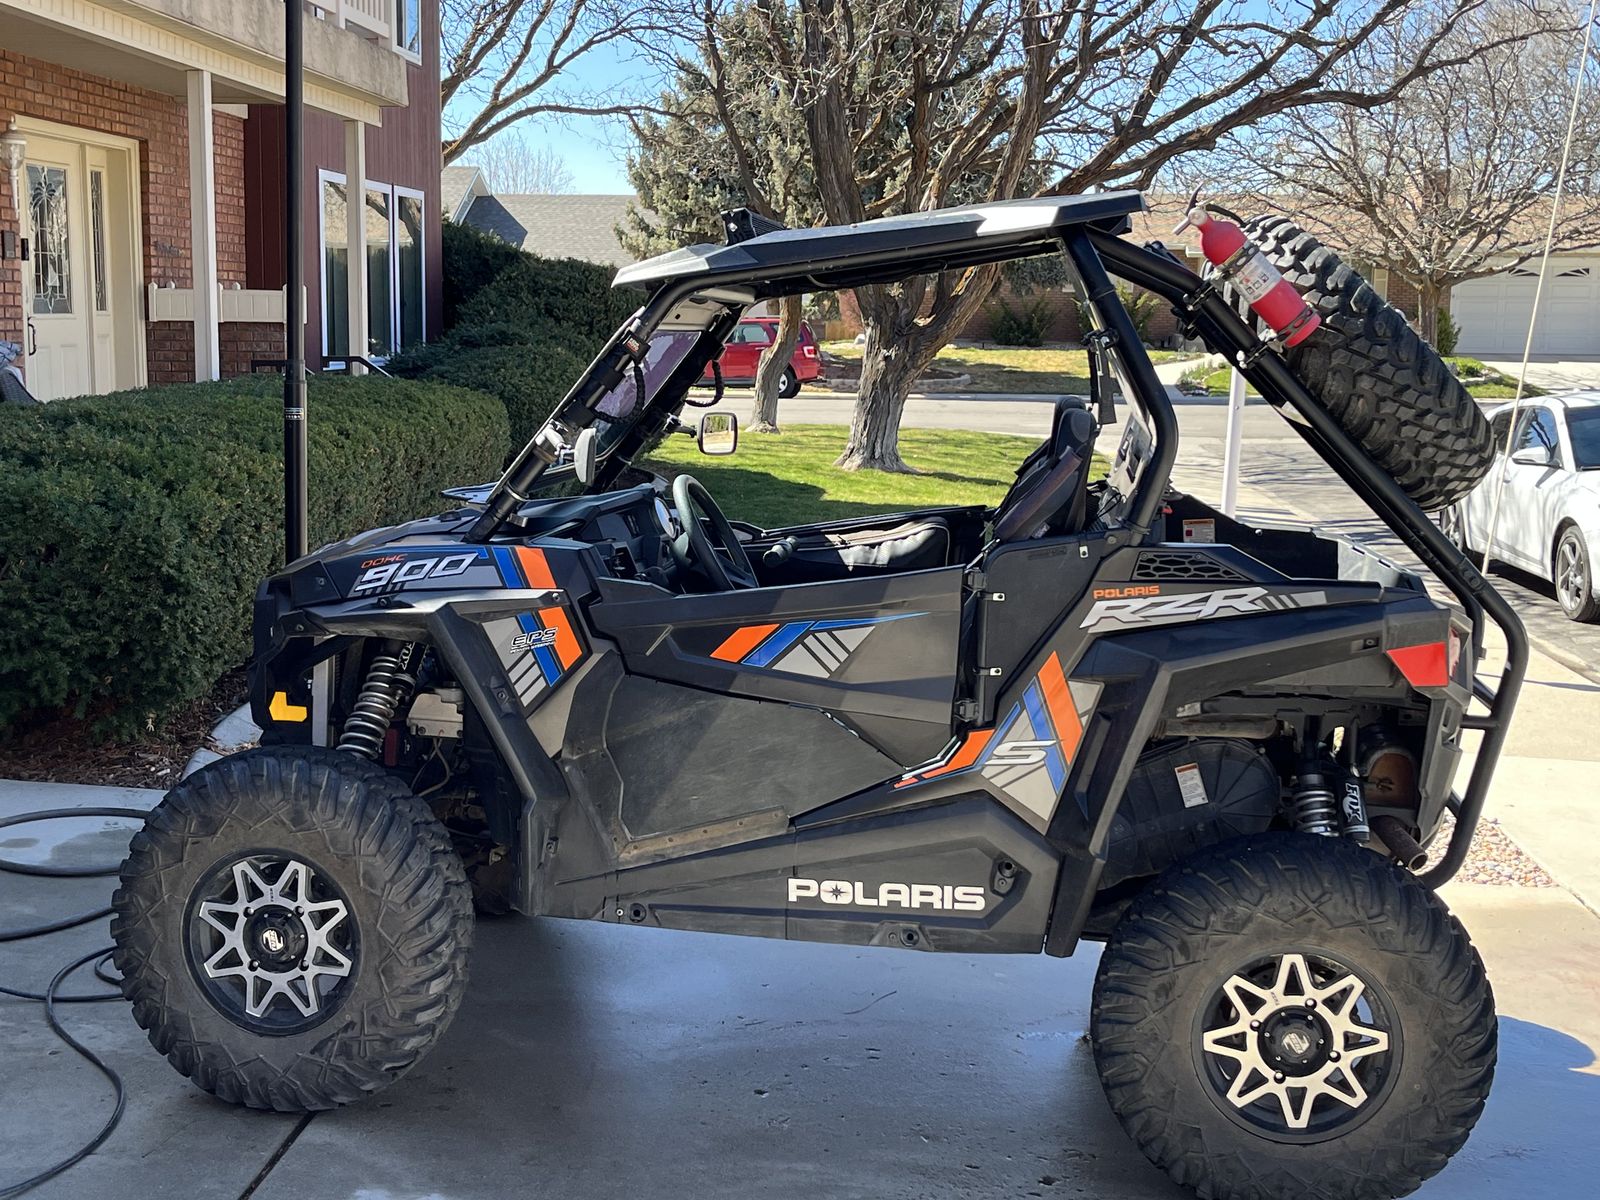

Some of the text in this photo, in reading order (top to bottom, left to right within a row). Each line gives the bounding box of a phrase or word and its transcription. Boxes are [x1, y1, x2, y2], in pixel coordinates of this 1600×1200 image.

[354, 553, 479, 591] 900
[1079, 587, 1268, 628] RZR
[1093, 586, 1160, 599] POLARIS
[511, 627, 558, 646] EPS
[984, 739, 1058, 765] S
[1344, 783, 1363, 822] FOX
[788, 878, 986, 911] POLARIS
